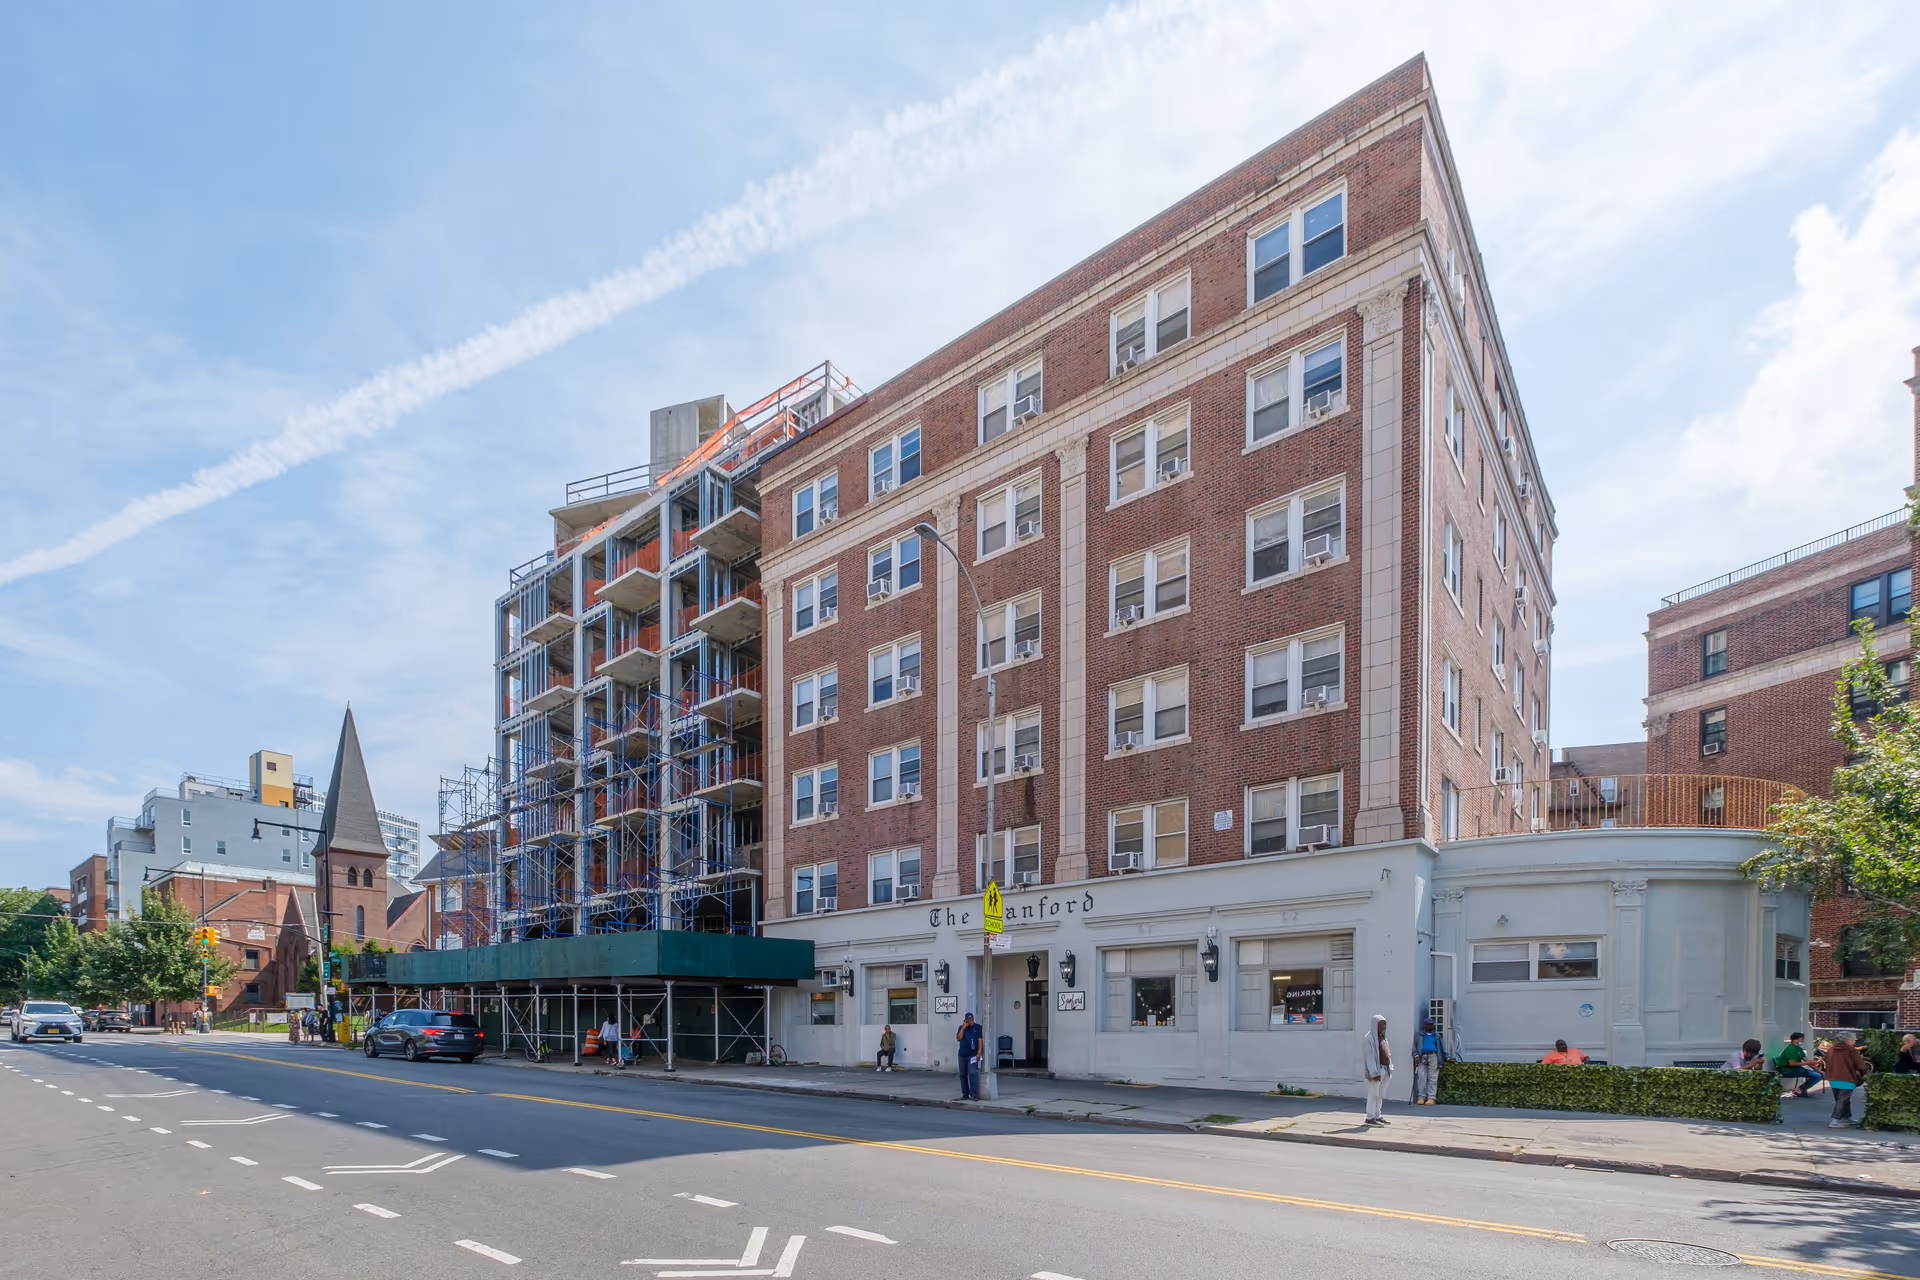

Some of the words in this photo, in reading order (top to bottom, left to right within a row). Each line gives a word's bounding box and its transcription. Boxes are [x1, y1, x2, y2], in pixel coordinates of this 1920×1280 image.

[929, 906, 970, 928] The
[1004, 890, 1094, 921] anford
[985, 919, 1002, 930] SCHOOL
